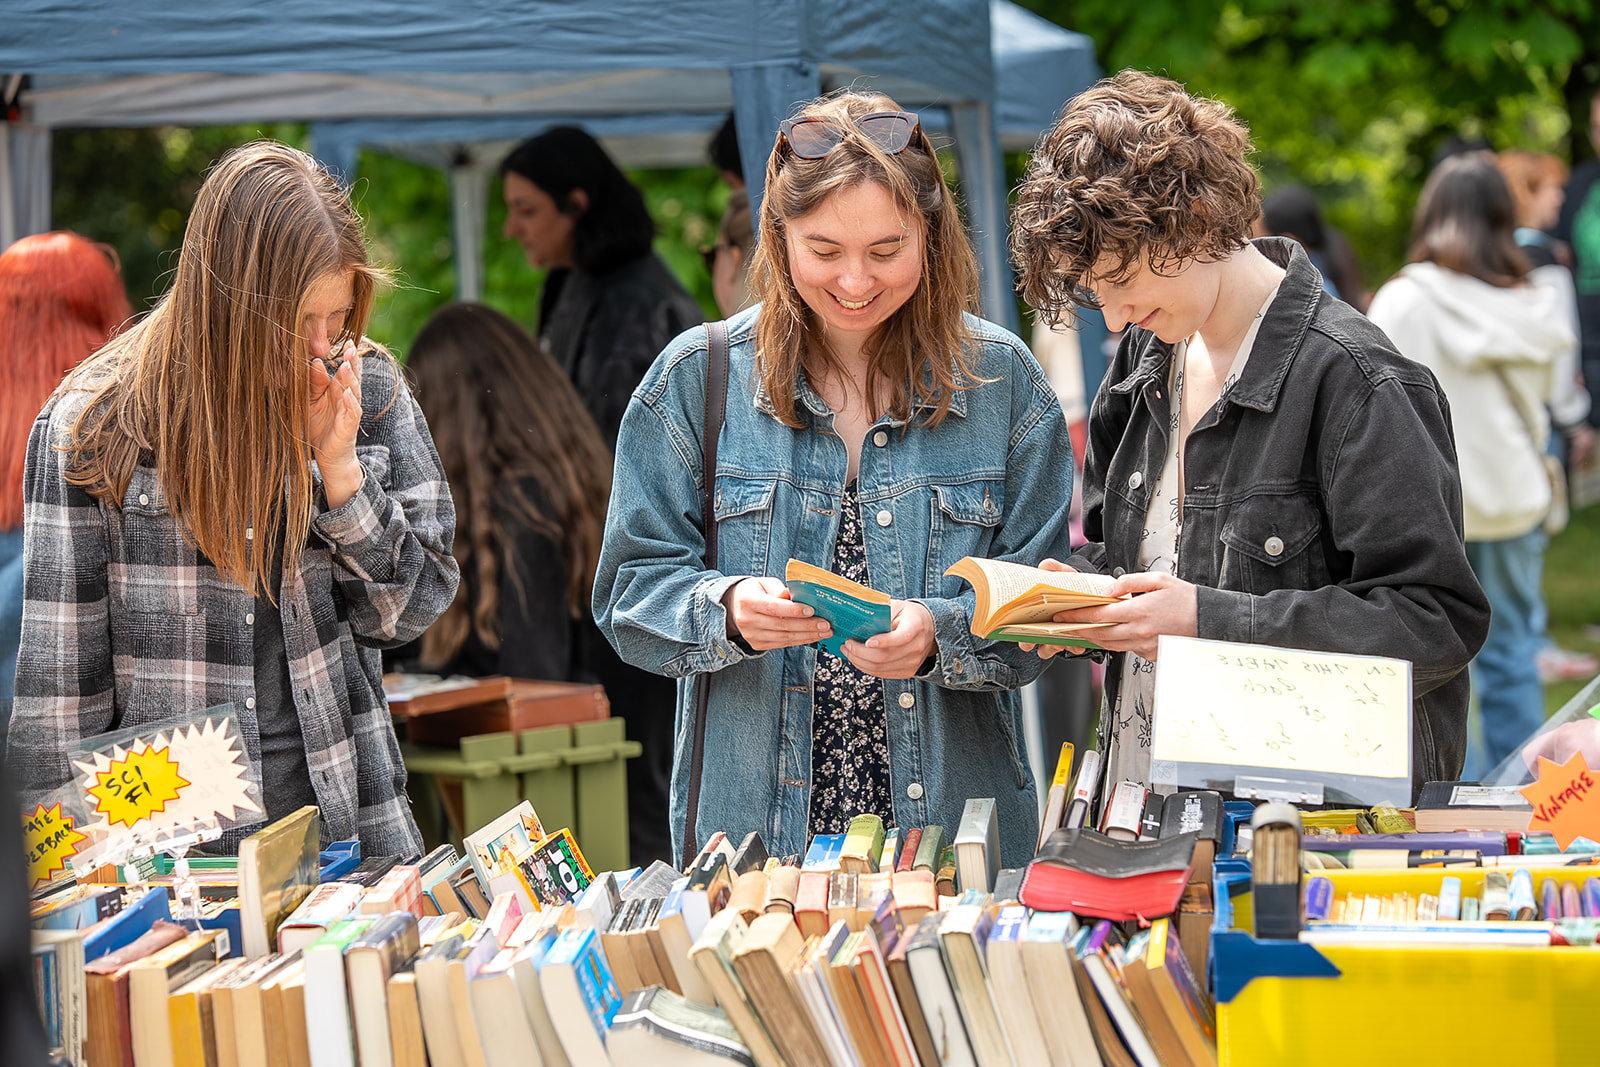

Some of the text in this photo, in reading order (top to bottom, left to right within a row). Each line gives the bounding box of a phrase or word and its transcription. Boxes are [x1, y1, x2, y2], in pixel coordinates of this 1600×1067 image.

[106, 766, 143, 797] SCI
[124, 782, 152, 806] FI
[1535, 771, 1594, 822] VINTAGE
